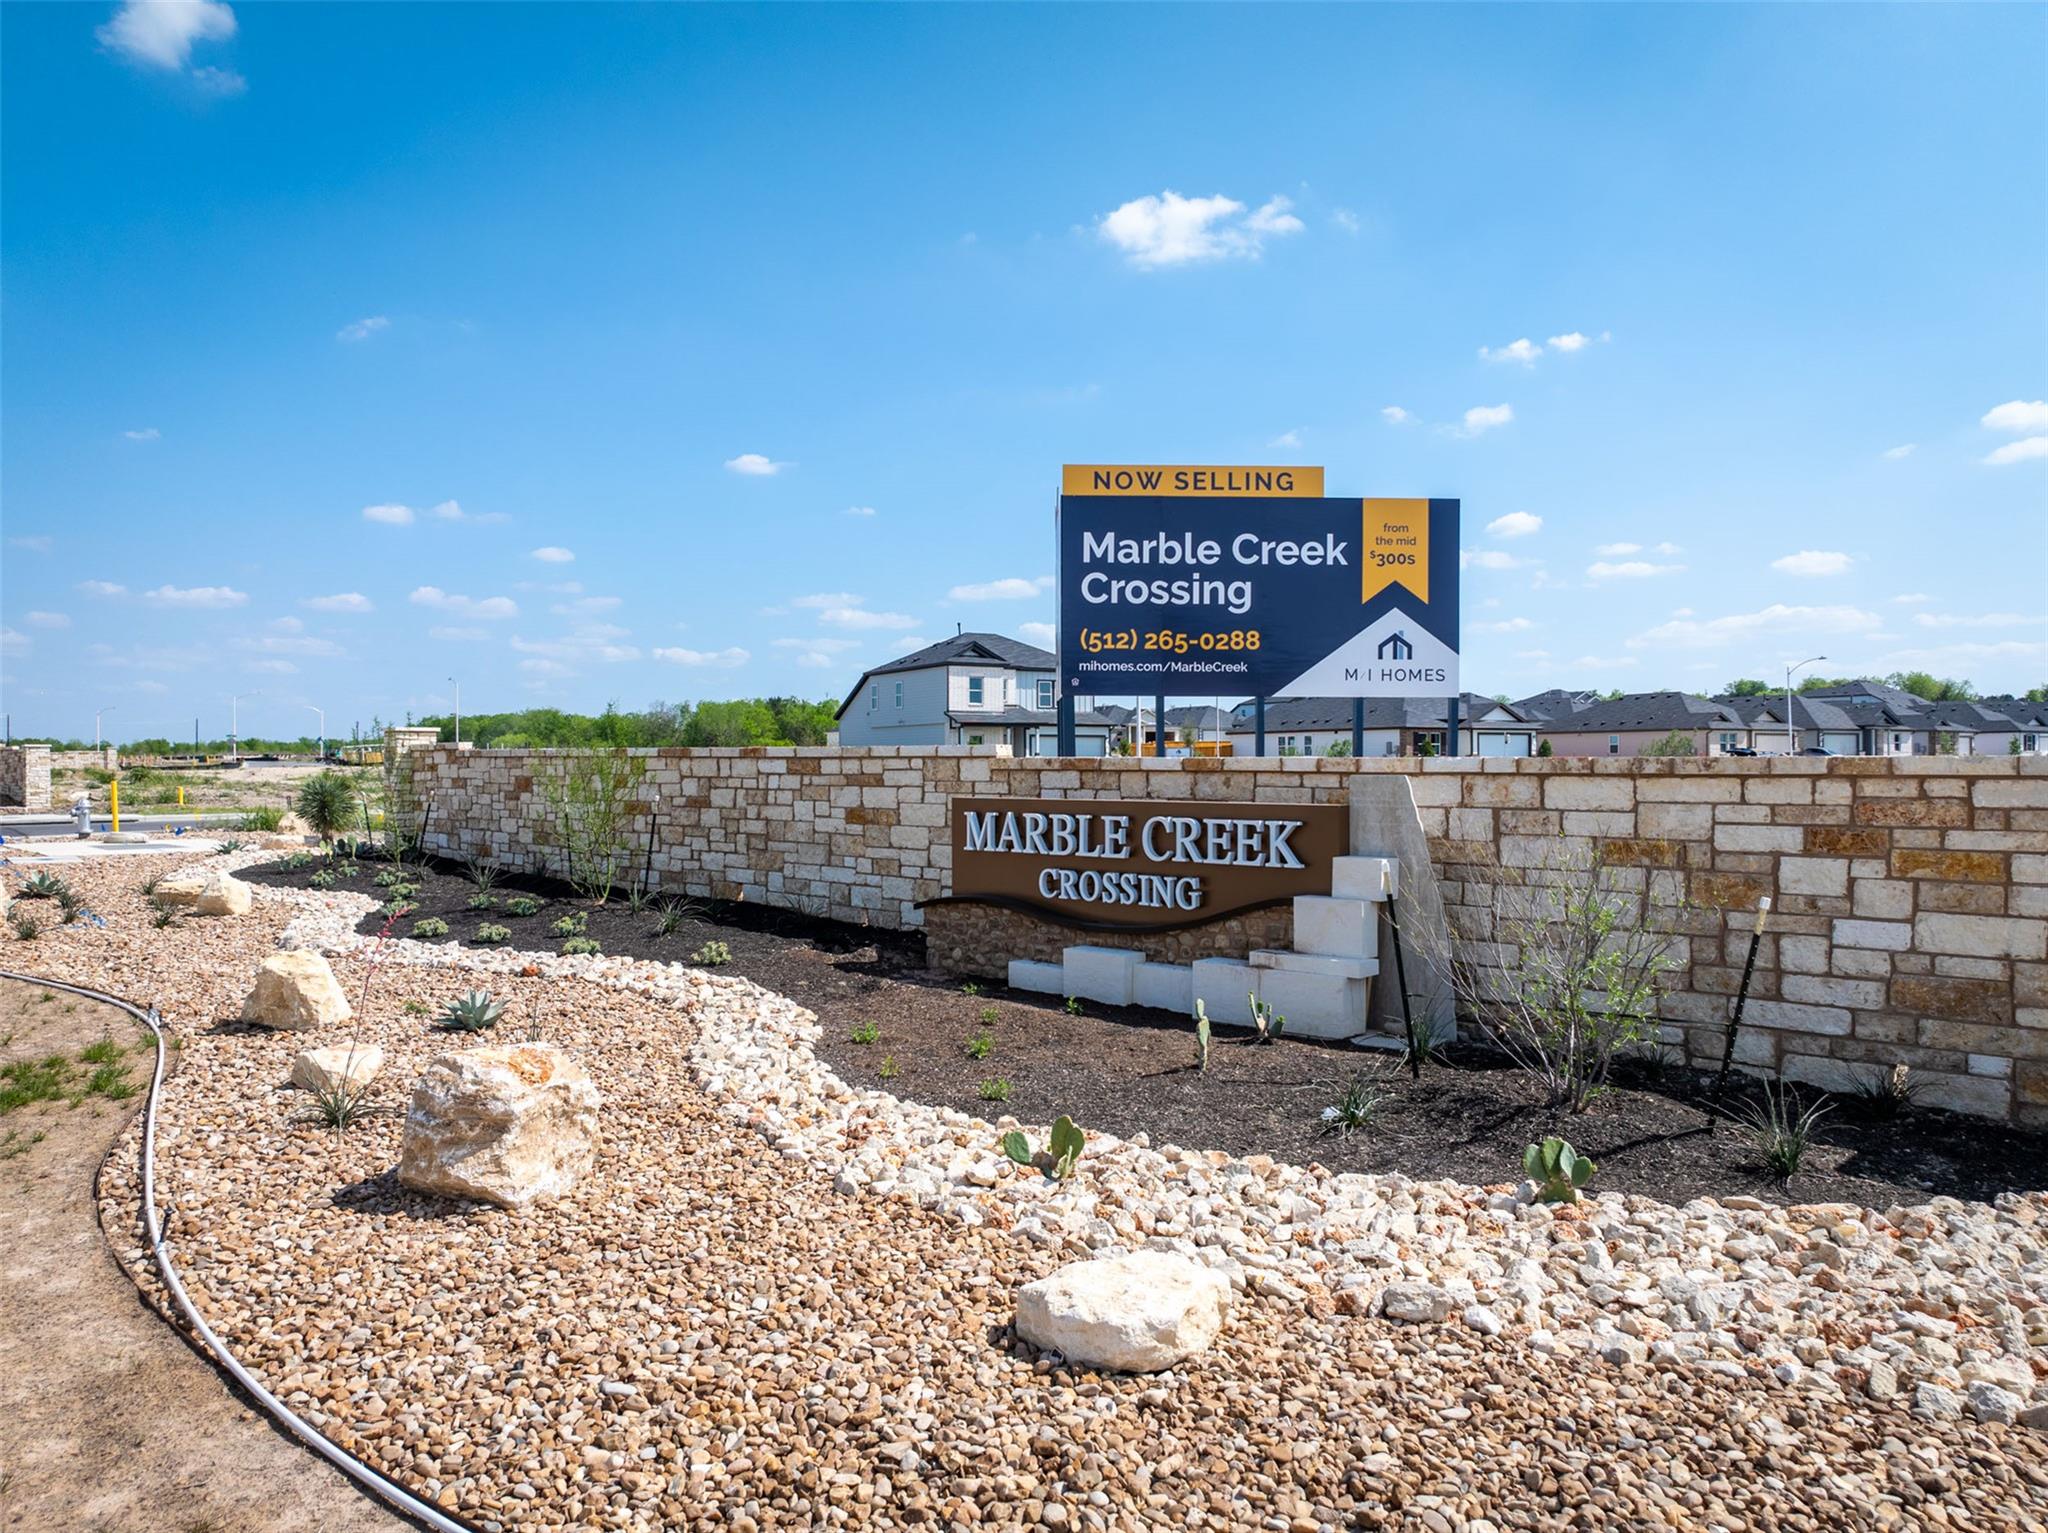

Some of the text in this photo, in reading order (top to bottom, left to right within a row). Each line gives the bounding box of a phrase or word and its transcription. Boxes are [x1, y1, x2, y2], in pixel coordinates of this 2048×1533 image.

[1093, 470, 1295, 492] NOW SELLING
[1383, 523, 1409, 533] from
[1082, 531, 1348, 567] Marble Creek
[1375, 536, 1417, 546] the mid
[1080, 572, 1252, 614] Crossing
[1080, 628, 1261, 654] (512) 265-0288
[1078, 660, 1248, 673] mihomes.com/MarbleCreek
[1381, 668, 1446, 682] HOMES
[963, 811, 1306, 869] MARBLE CREEK
[1038, 868, 1202, 910] CROSSING
